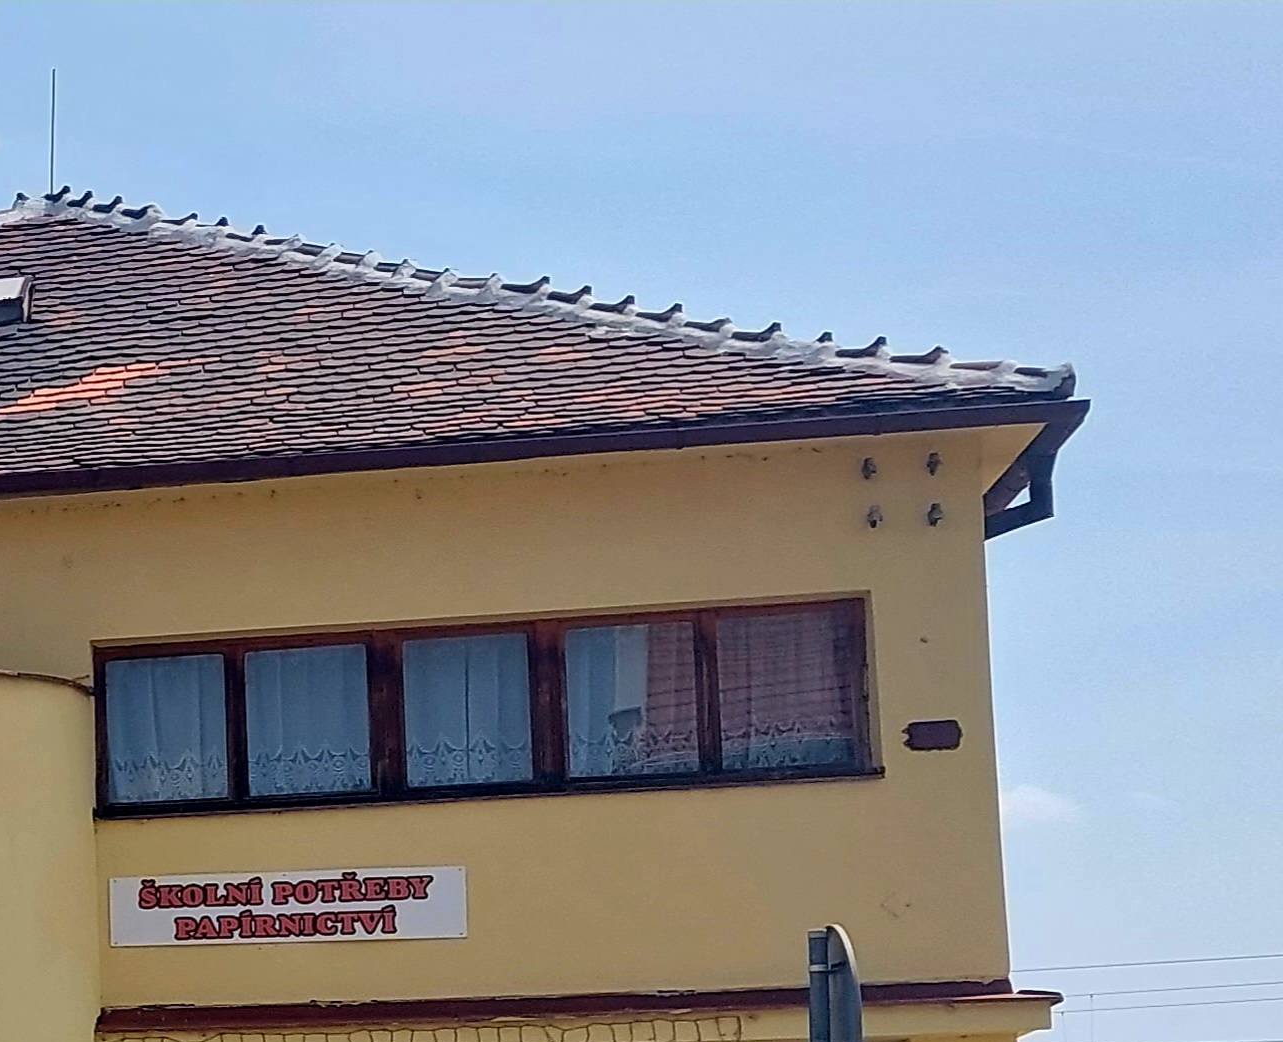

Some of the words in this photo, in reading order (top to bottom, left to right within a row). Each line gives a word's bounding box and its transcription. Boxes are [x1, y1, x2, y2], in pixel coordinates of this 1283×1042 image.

[139, 878, 264, 909] ŠKOLNÍ
[271, 872, 434, 905] POTŘEBY
[174, 904, 397, 940] PAPÍRNICTVÍ
